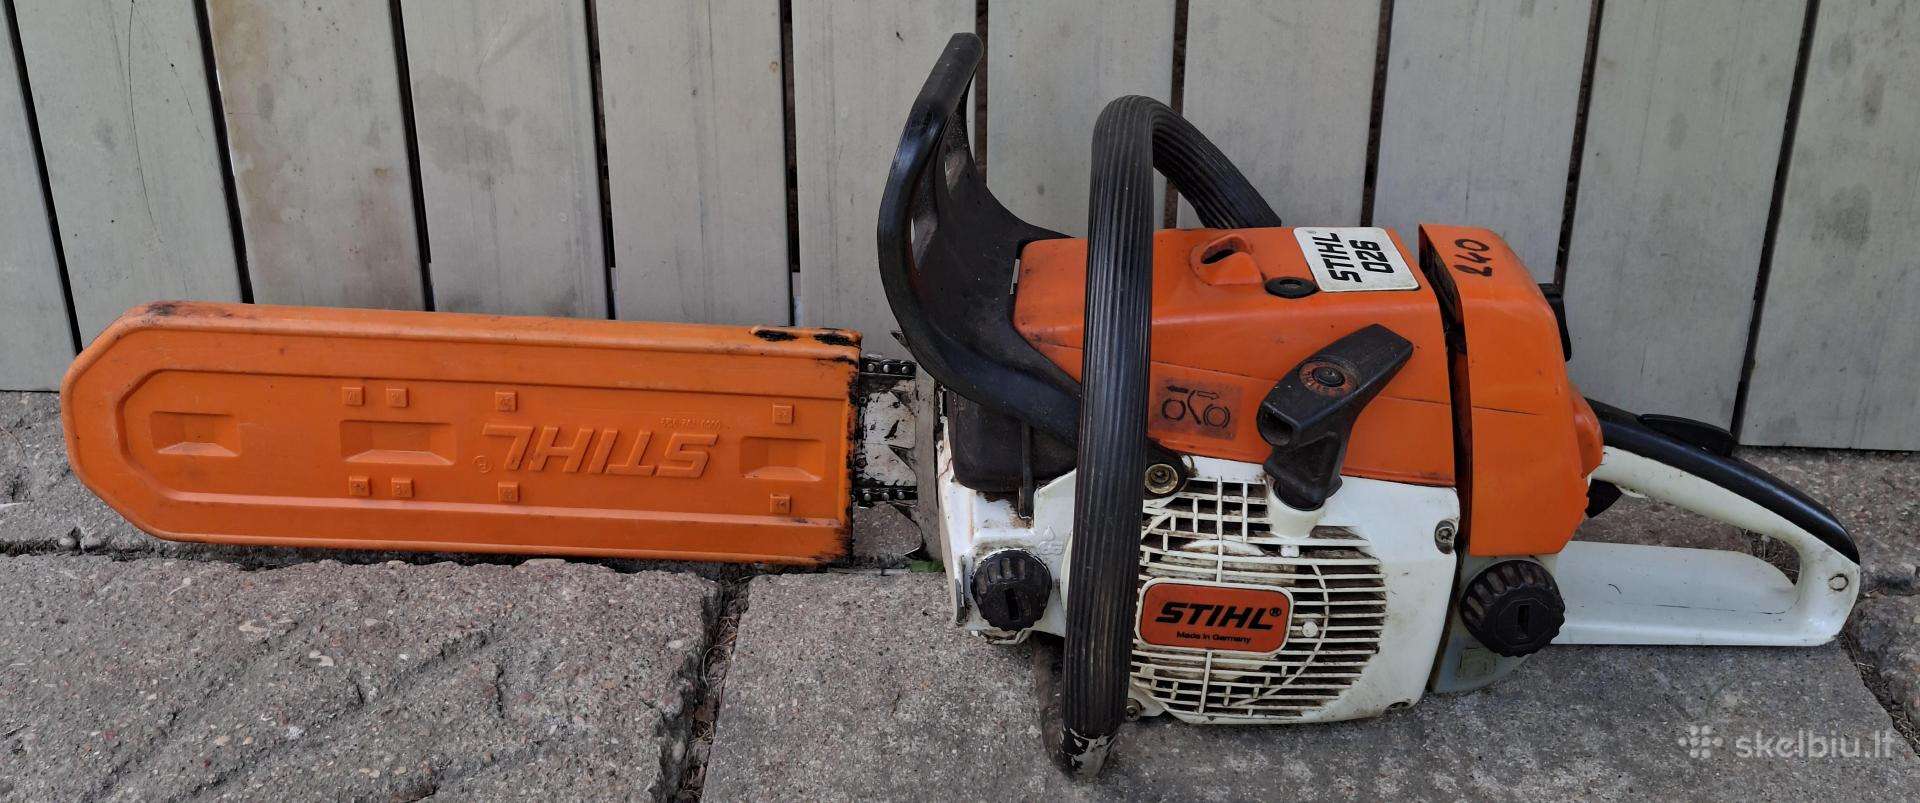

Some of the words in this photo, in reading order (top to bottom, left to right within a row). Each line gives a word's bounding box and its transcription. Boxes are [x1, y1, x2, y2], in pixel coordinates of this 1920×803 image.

[1312, 232, 1362, 282] STIHL
[1350, 239, 1394, 273] 026
[1176, 631, 1201, 639] Made
[1212, 634, 1251, 643] Germany
